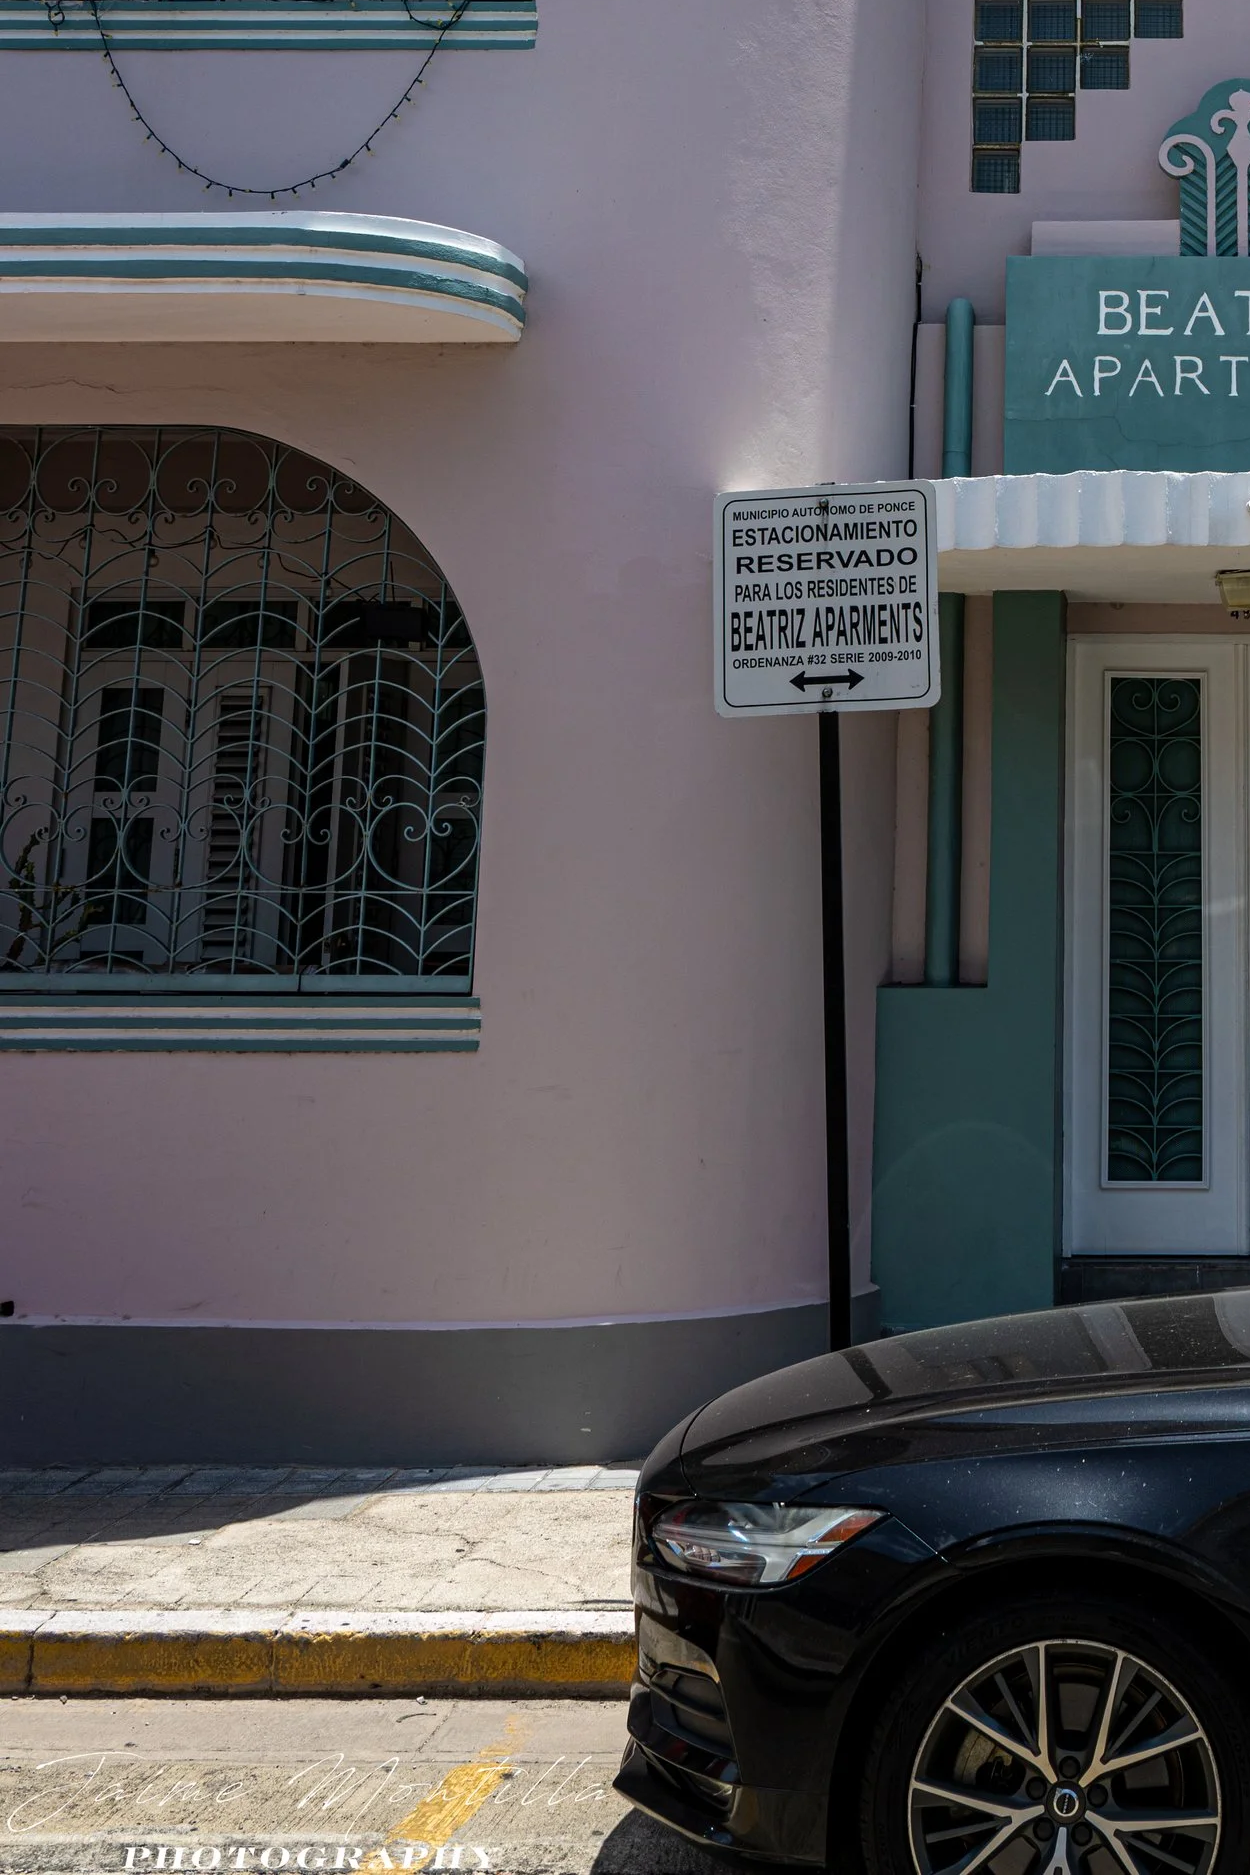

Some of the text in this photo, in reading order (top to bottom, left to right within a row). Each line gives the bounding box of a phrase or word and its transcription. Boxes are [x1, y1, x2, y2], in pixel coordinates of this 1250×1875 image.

[732, 509, 790, 521] MUNICIPIO
[859, 504, 875, 514] DE
[877, 501, 916, 513] PONCE
[732, 519, 918, 547] ESTACIONAMIENTO
[736, 547, 918, 574] RESERVADO
[735, 575, 917, 603] PARA LOS RESIDENTES DE
[731, 601, 924, 652] BEATRIZ APARMENTS
[732, 649, 922, 669] ORDENANZA #32 SERIE 2009-2010
